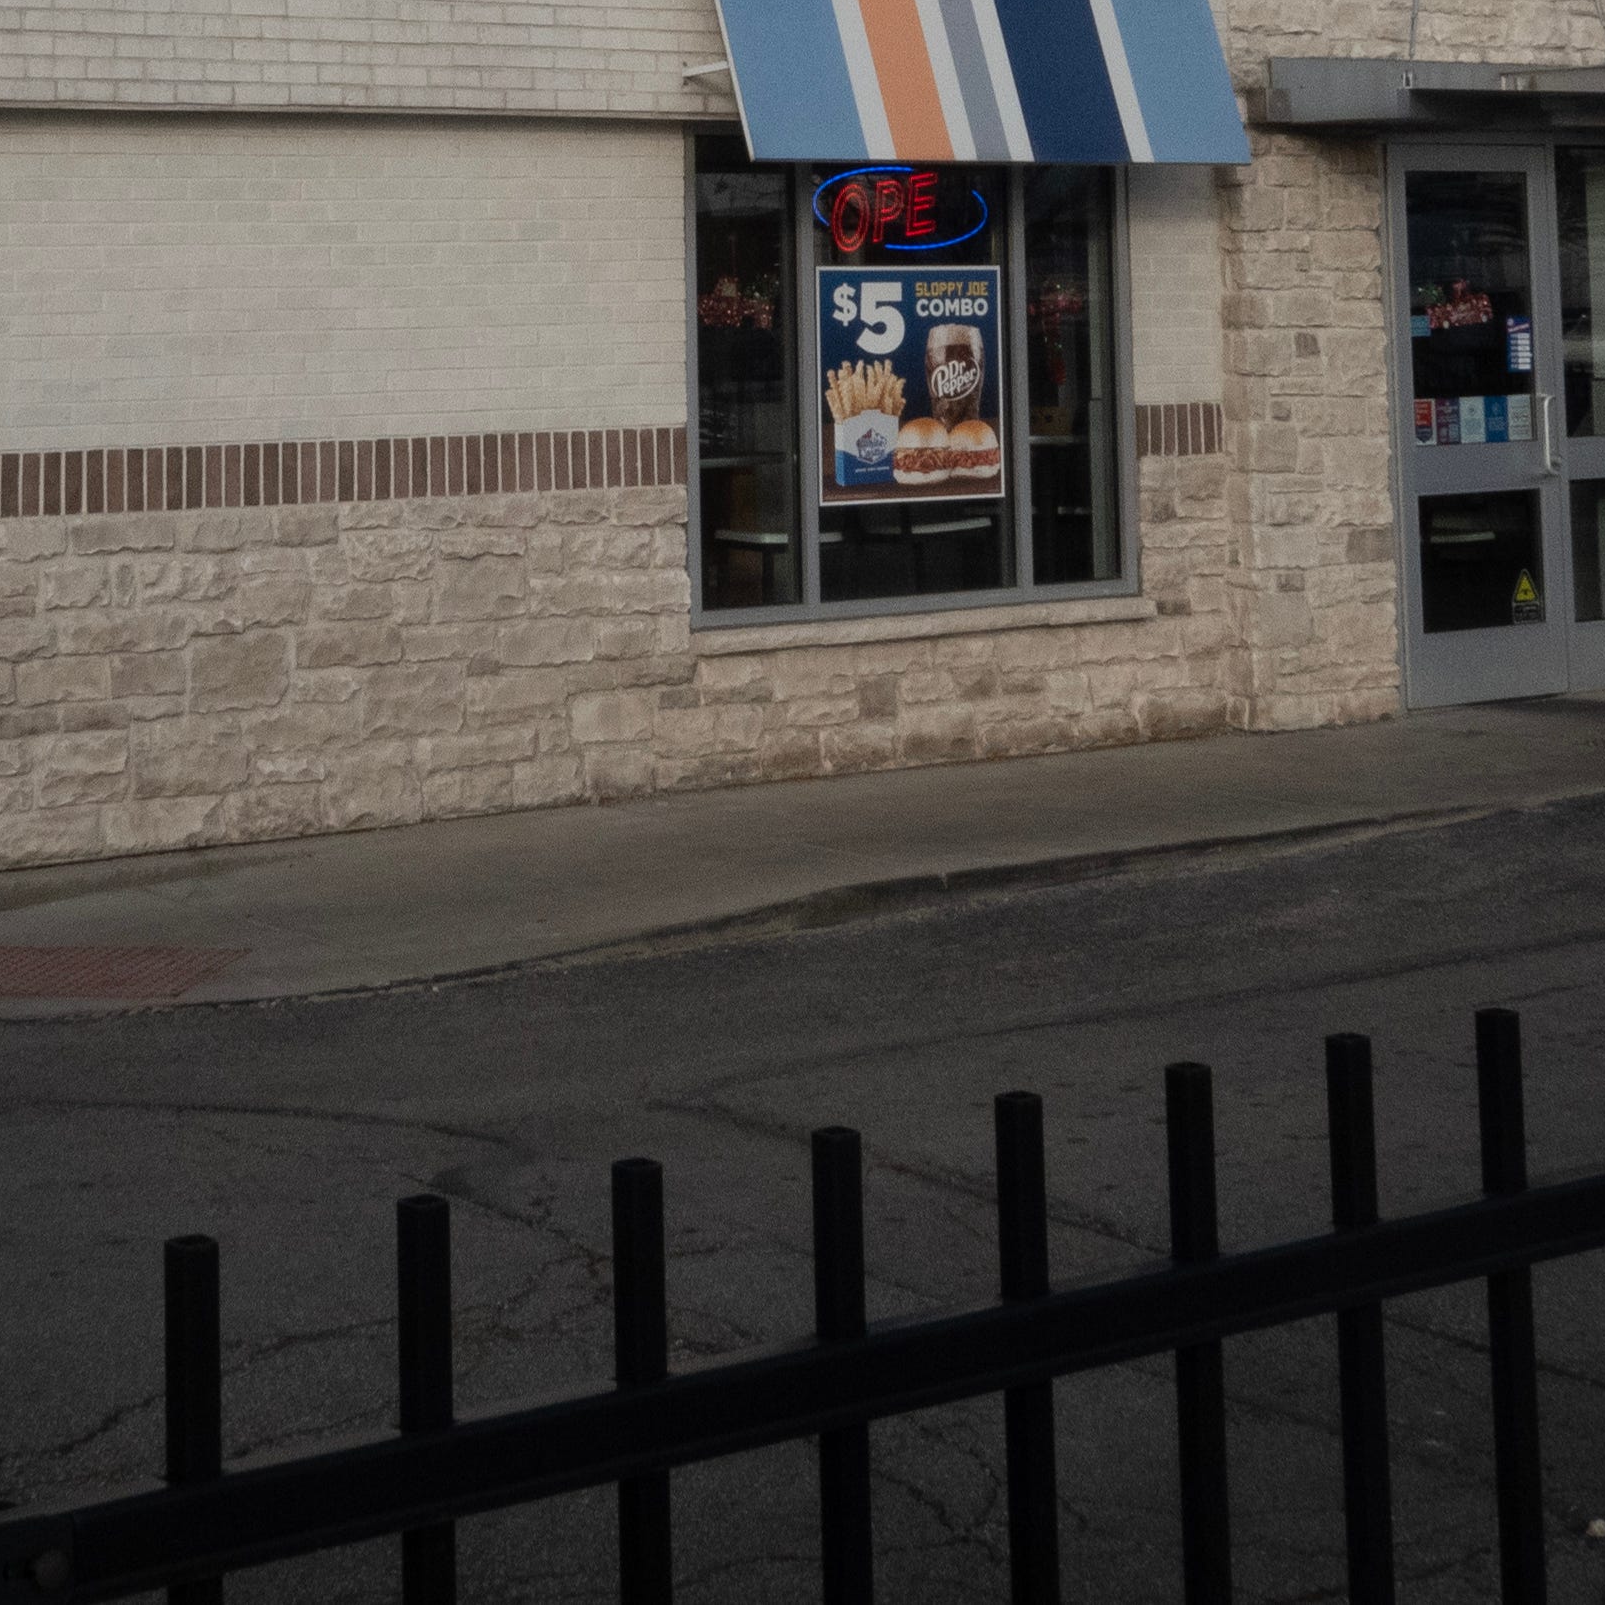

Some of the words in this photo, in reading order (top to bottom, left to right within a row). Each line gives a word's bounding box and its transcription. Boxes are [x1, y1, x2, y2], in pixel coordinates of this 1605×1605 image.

[914, 280, 964, 298] SLOPPY
[965, 280, 989, 297] JOE
[831, 281, 906, 355] $5
[914, 297, 990, 318] COMBO
[948, 359, 967, 379] Dr
[932, 364, 977, 398] Pepper
